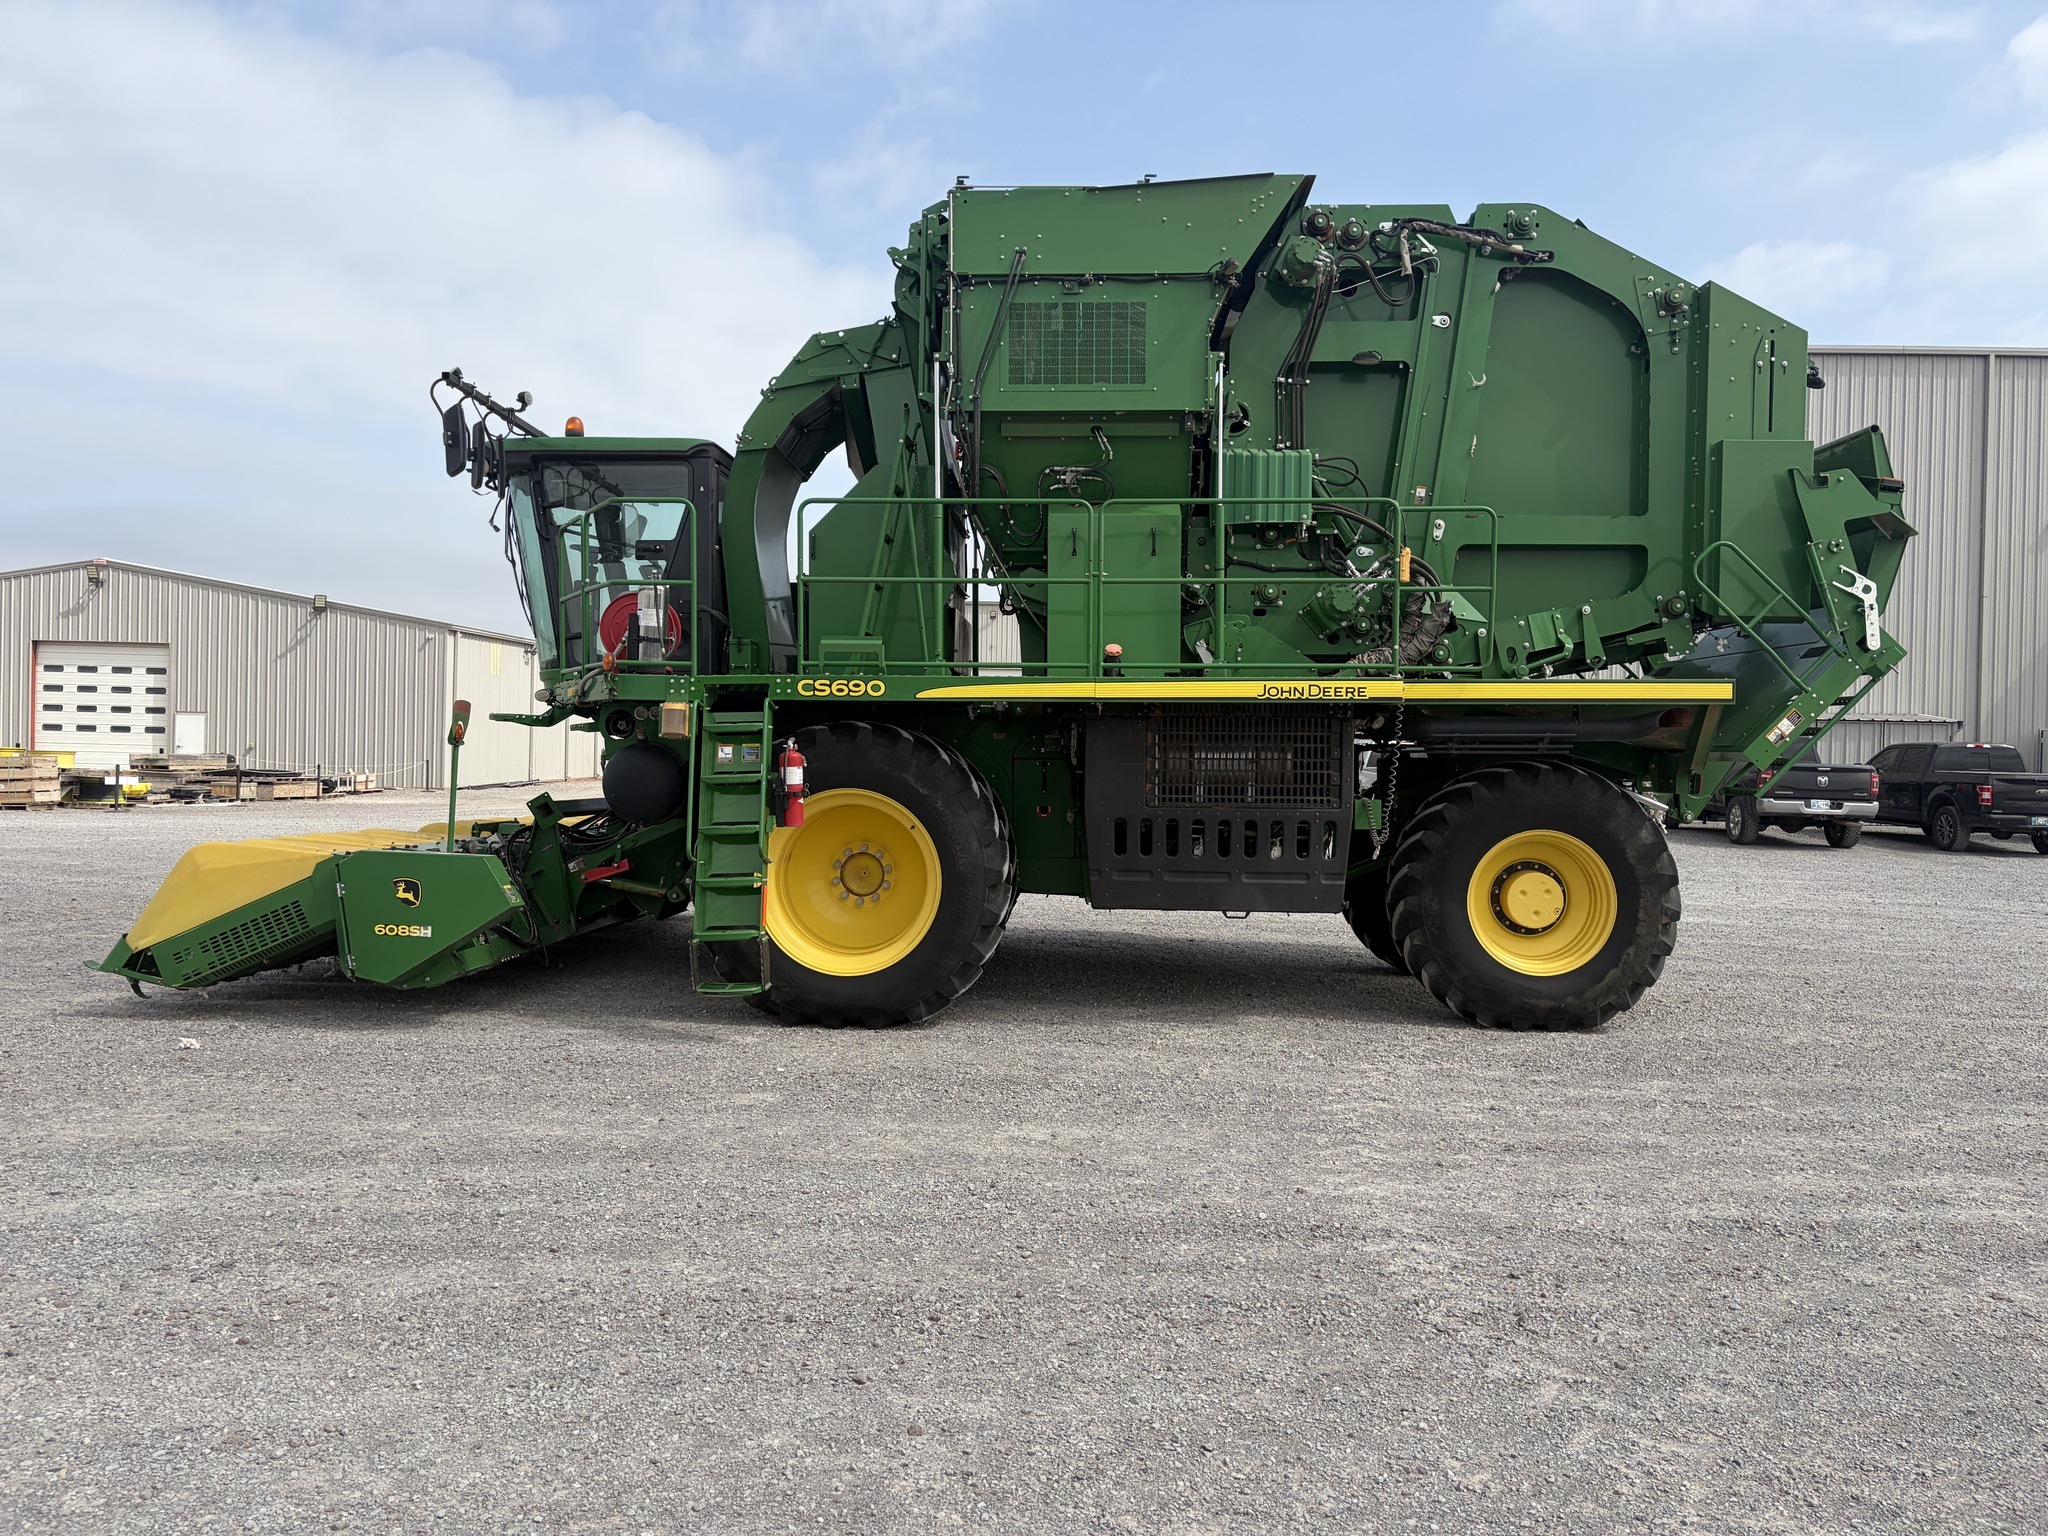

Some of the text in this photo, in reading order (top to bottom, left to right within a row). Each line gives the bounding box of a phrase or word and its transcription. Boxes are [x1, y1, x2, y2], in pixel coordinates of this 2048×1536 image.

[797, 679, 886, 697] CS690
[1257, 684, 1368, 698] JOHN DEERE
[374, 924, 432, 938] 608SH
